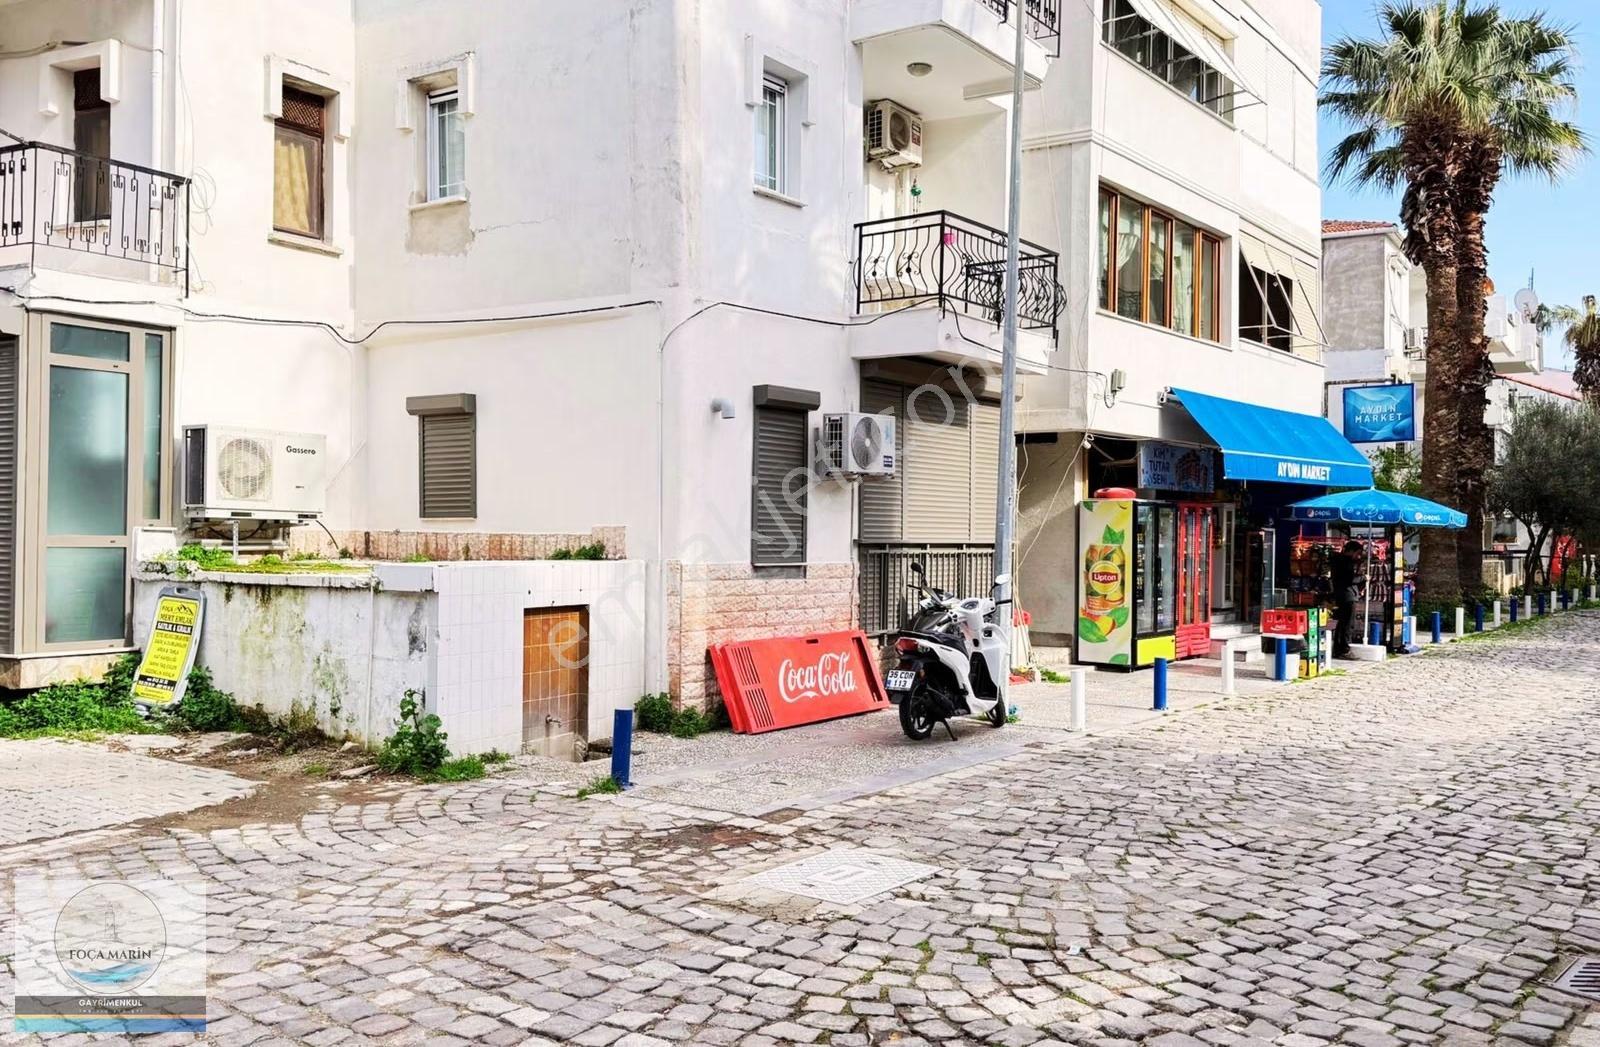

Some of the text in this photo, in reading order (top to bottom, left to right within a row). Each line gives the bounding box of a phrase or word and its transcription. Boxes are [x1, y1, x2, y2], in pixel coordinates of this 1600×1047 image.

[1360, 404, 1396, 414] AYDIN
[1354, 413, 1402, 423] MARKET
[286, 445, 316, 455] Gassero
[1148, 460, 1170, 473] TUTAR
[1301, 463, 1330, 480] MARKET
[1094, 573, 1117, 582] Lipton
